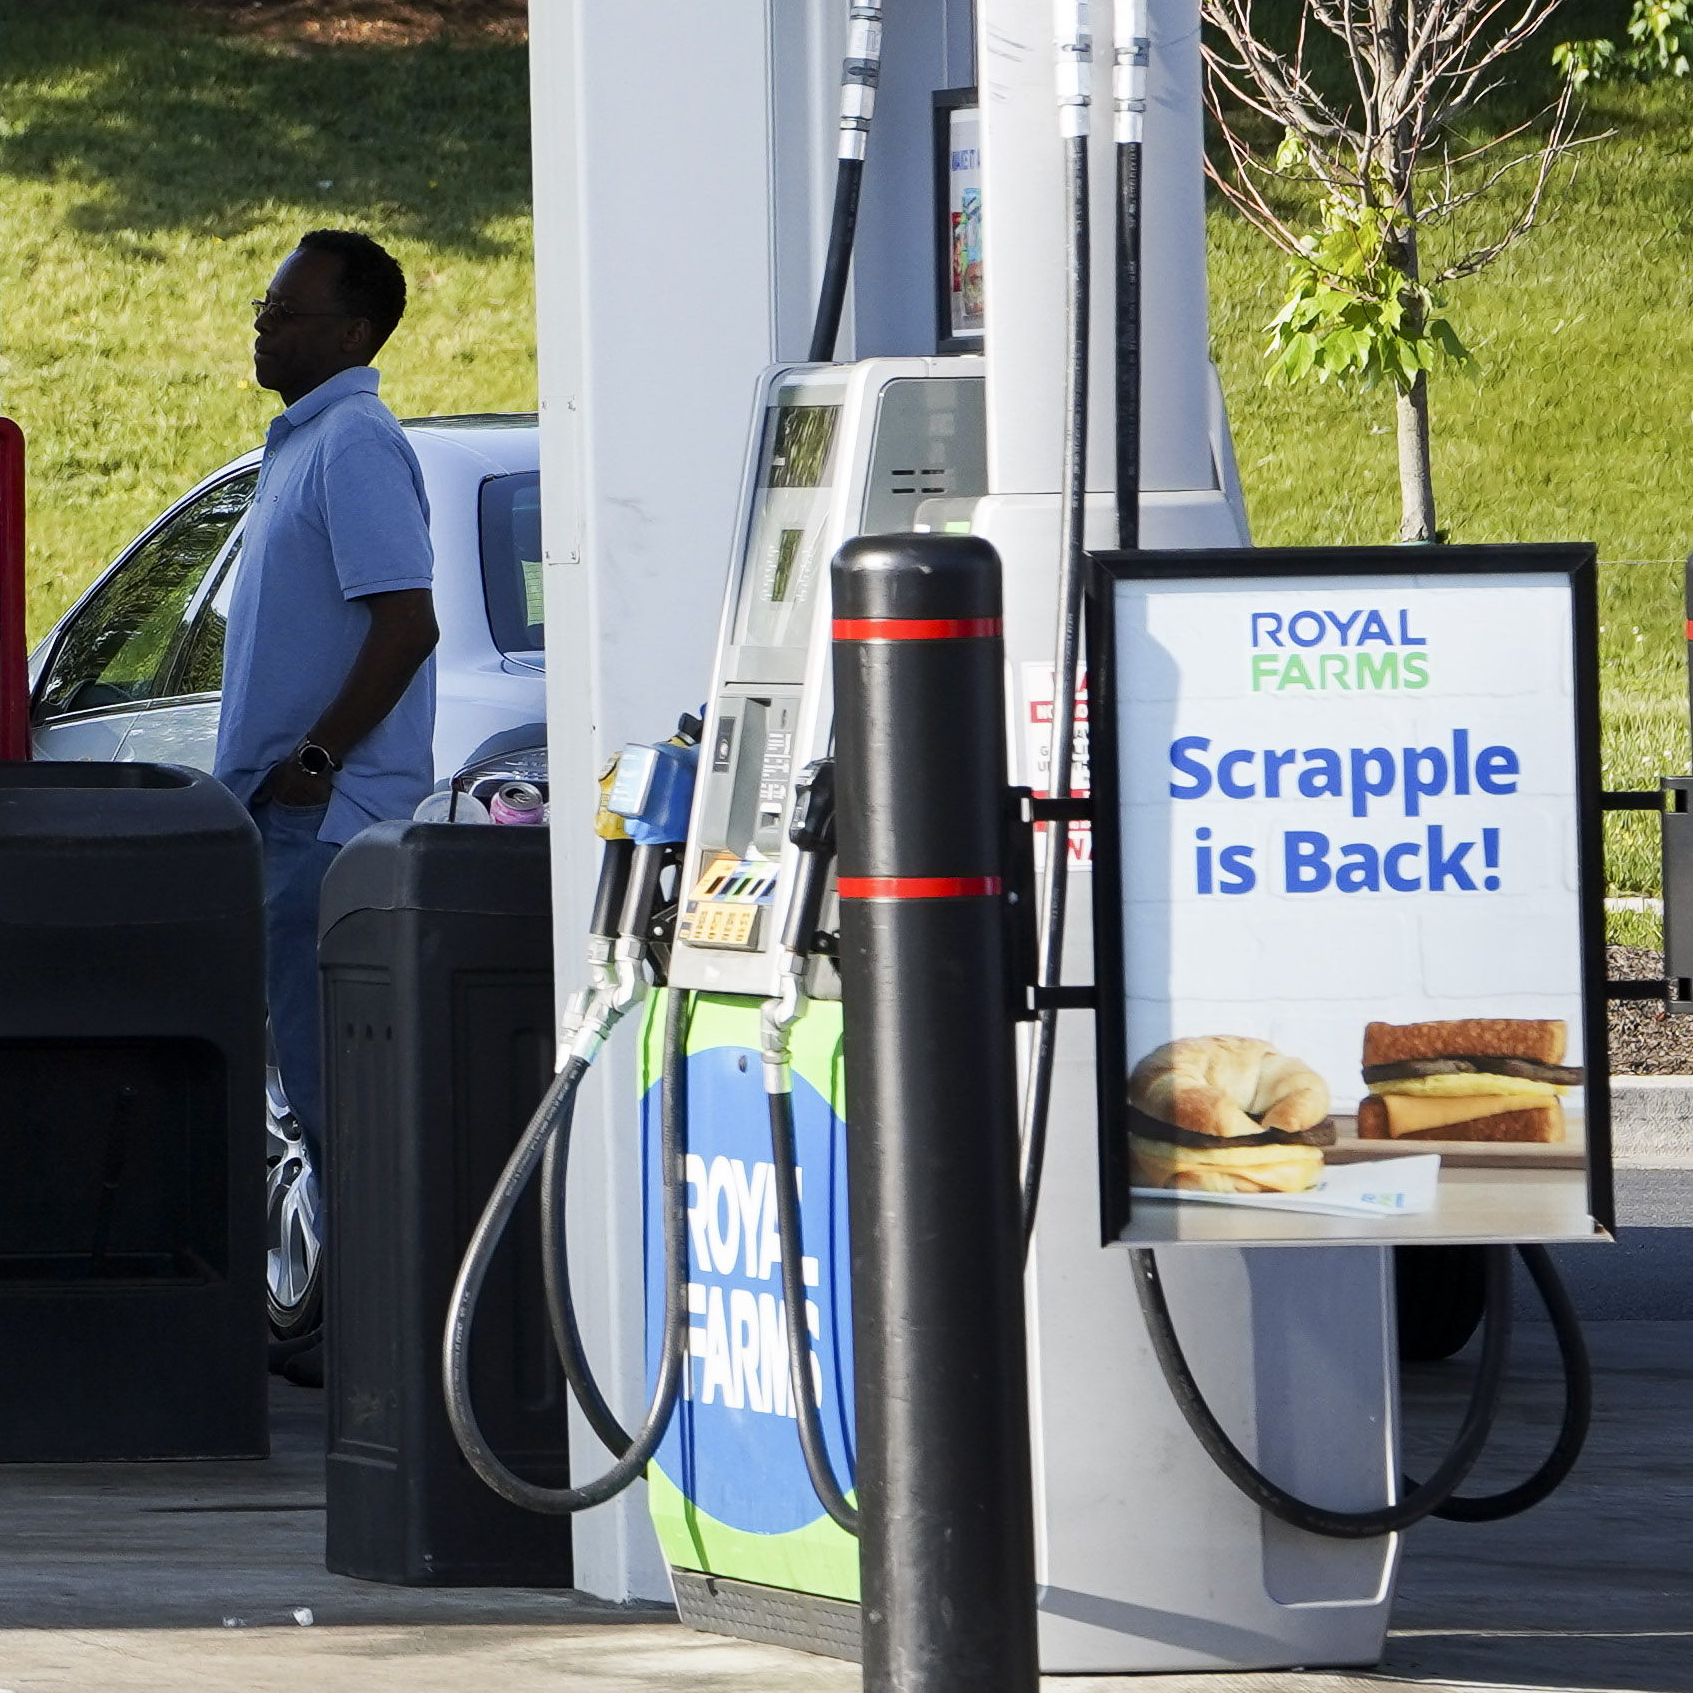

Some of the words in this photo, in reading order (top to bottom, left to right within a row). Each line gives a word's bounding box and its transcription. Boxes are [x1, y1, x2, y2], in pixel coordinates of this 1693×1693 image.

[1251, 609, 1428, 647] ROYAL
[1252, 651, 1430, 691] FARMS
[1169, 728, 1519, 817] Scrapple
[1194, 827, 1257, 896] is
[1284, 825, 1501, 894] Back!
